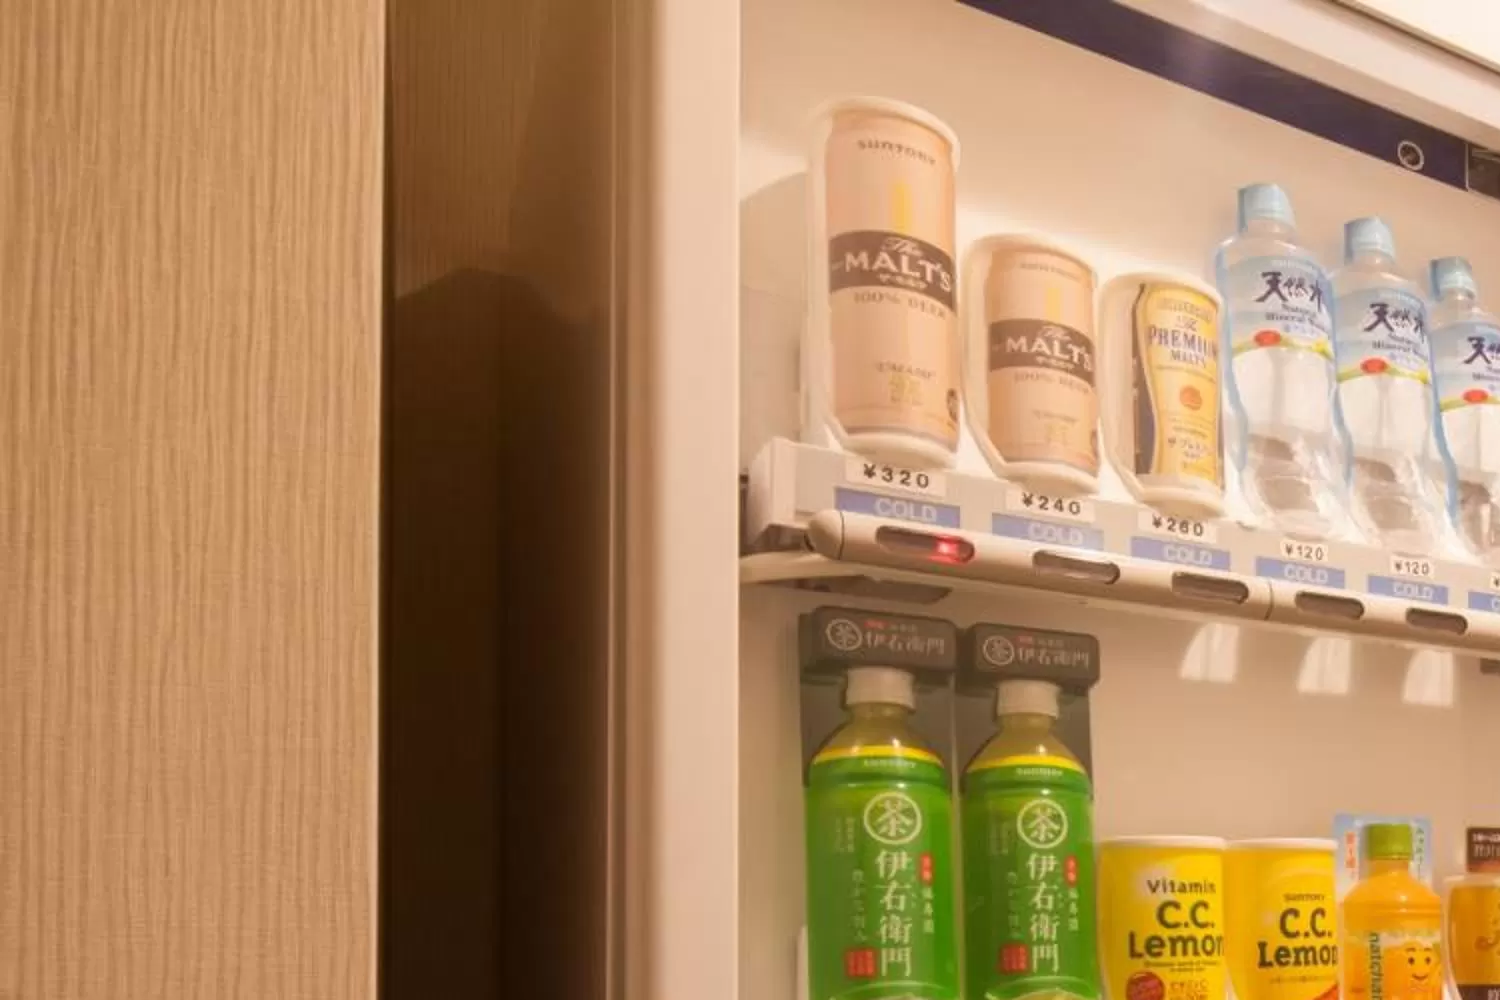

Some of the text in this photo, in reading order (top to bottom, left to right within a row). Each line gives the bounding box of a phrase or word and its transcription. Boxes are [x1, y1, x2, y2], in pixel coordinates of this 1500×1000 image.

[844, 250, 952, 293] MALT'S
[862, 463, 930, 490] ¥320
[874, 500, 938, 524] COLD
[1021, 491, 1082, 515] ¥240
[1027, 522, 1084, 546] COLD
[1162, 543, 1213, 567] COLD
[1284, 543, 1324, 561] ¥120
[1283, 563, 1328, 584] COLD
[1394, 560, 1430, 576] ¥120
[875, 849, 914, 978] 伊右衛門
[1026, 852, 1060, 974] 伊右衛門
[1156, 900, 1215, 930] C.C.
[1279, 907, 1333, 940] C.C.
